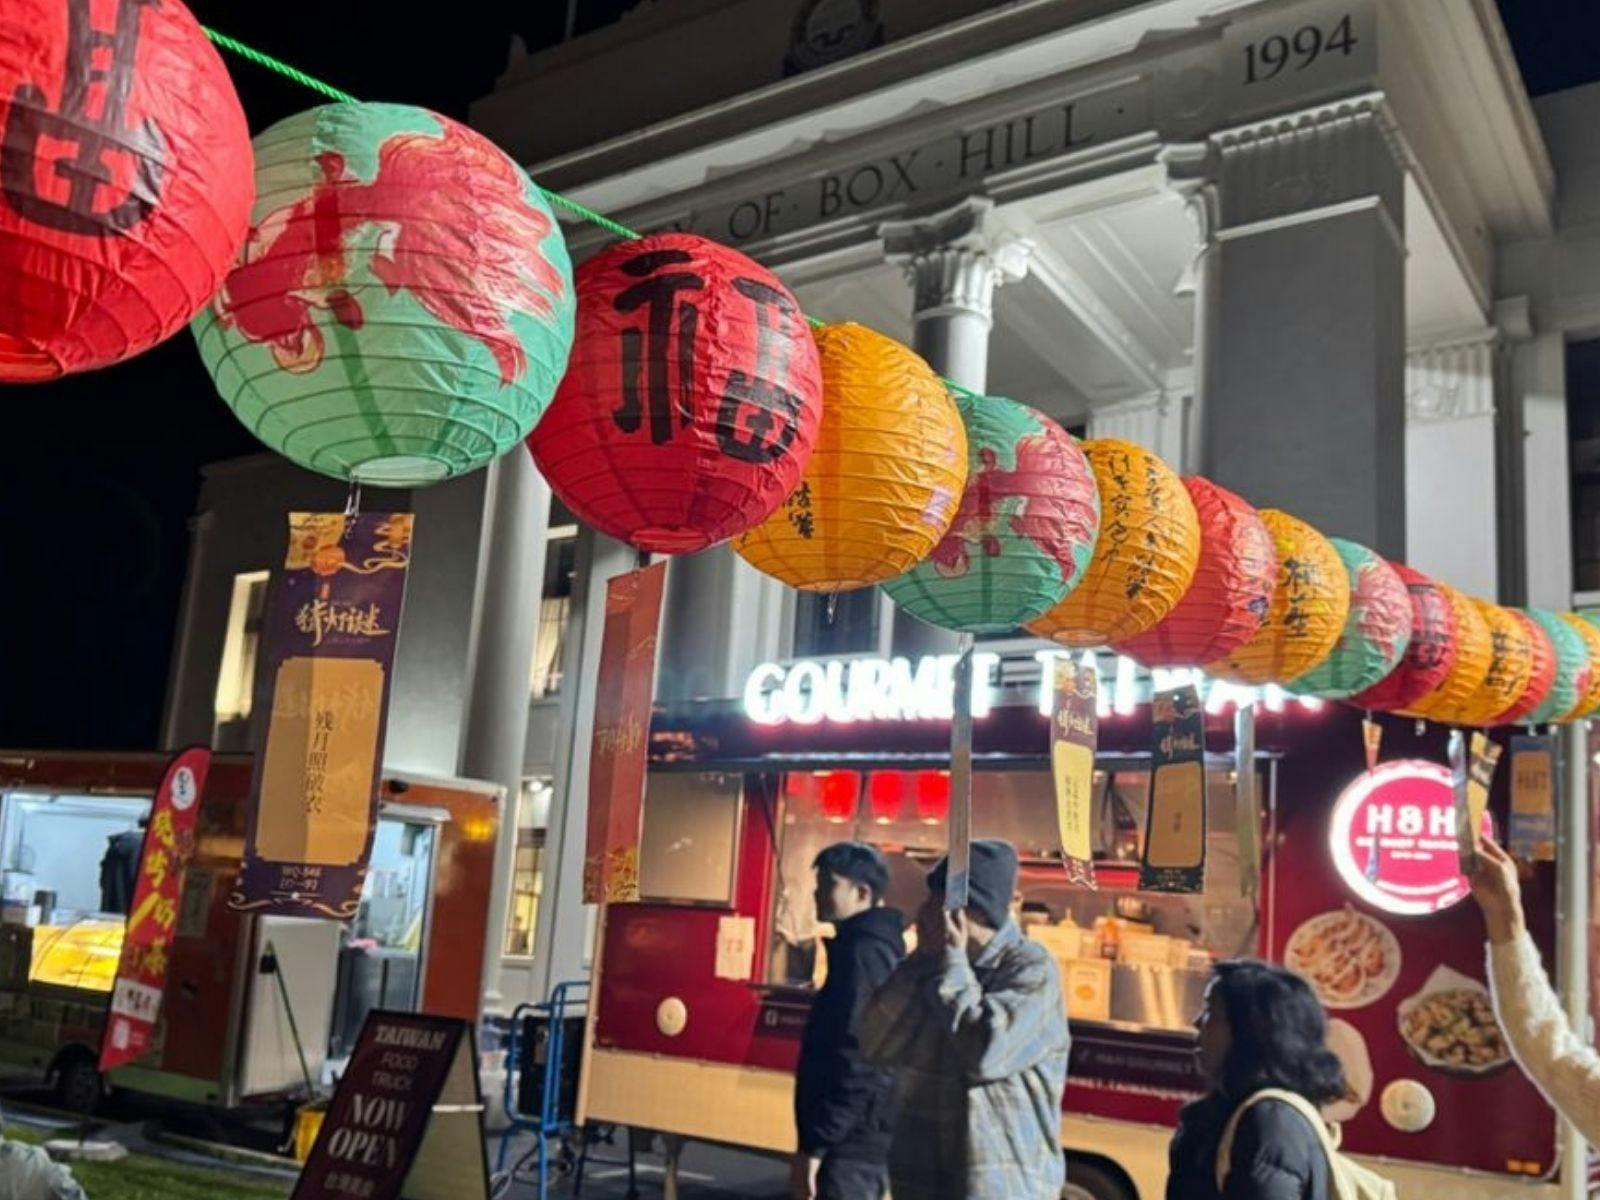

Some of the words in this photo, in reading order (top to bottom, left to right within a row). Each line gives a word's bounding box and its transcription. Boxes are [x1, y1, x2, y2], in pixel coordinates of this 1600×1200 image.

[1242, 14, 1358, 85] 1994
[728, 187, 785, 240] OF
[819, 149, 920, 218] BOX
[959, 104, 1096, 178] HILL
[743, 652, 1001, 726] GOURMET
[374, 1025, 446, 1050] TAIWAN
[347, 1093, 406, 1131] NOW
[328, 1128, 398, 1168] OPEN
